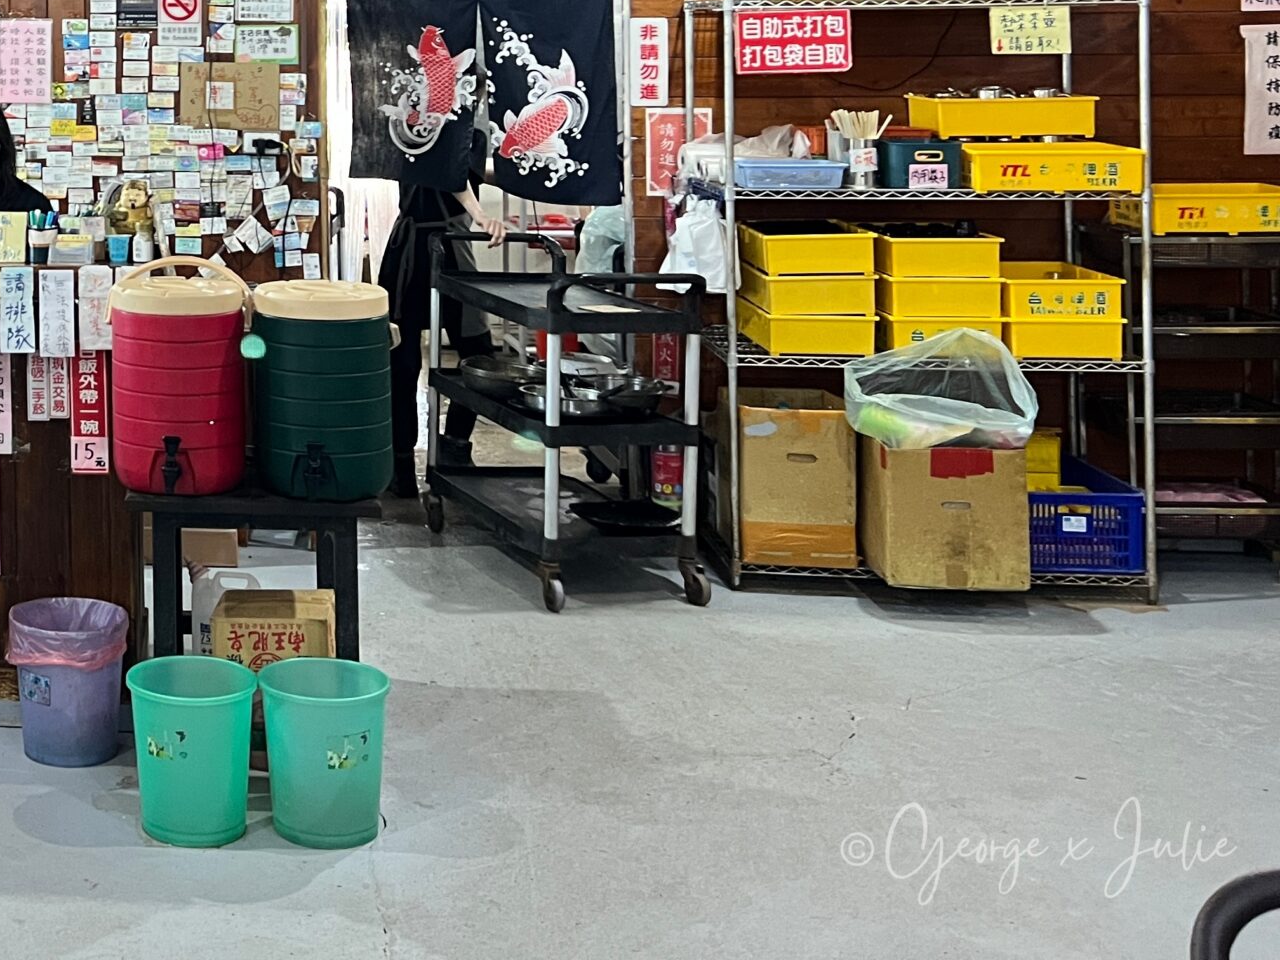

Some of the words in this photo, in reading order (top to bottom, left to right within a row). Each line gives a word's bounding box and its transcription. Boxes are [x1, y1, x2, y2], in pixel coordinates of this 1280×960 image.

[740, 15, 846, 40] 自助式打包
[639, 23, 660, 101] 非請勿進
[741, 42, 847, 68] 打包袋自取
[2, 272, 35, 350] 請排隊
